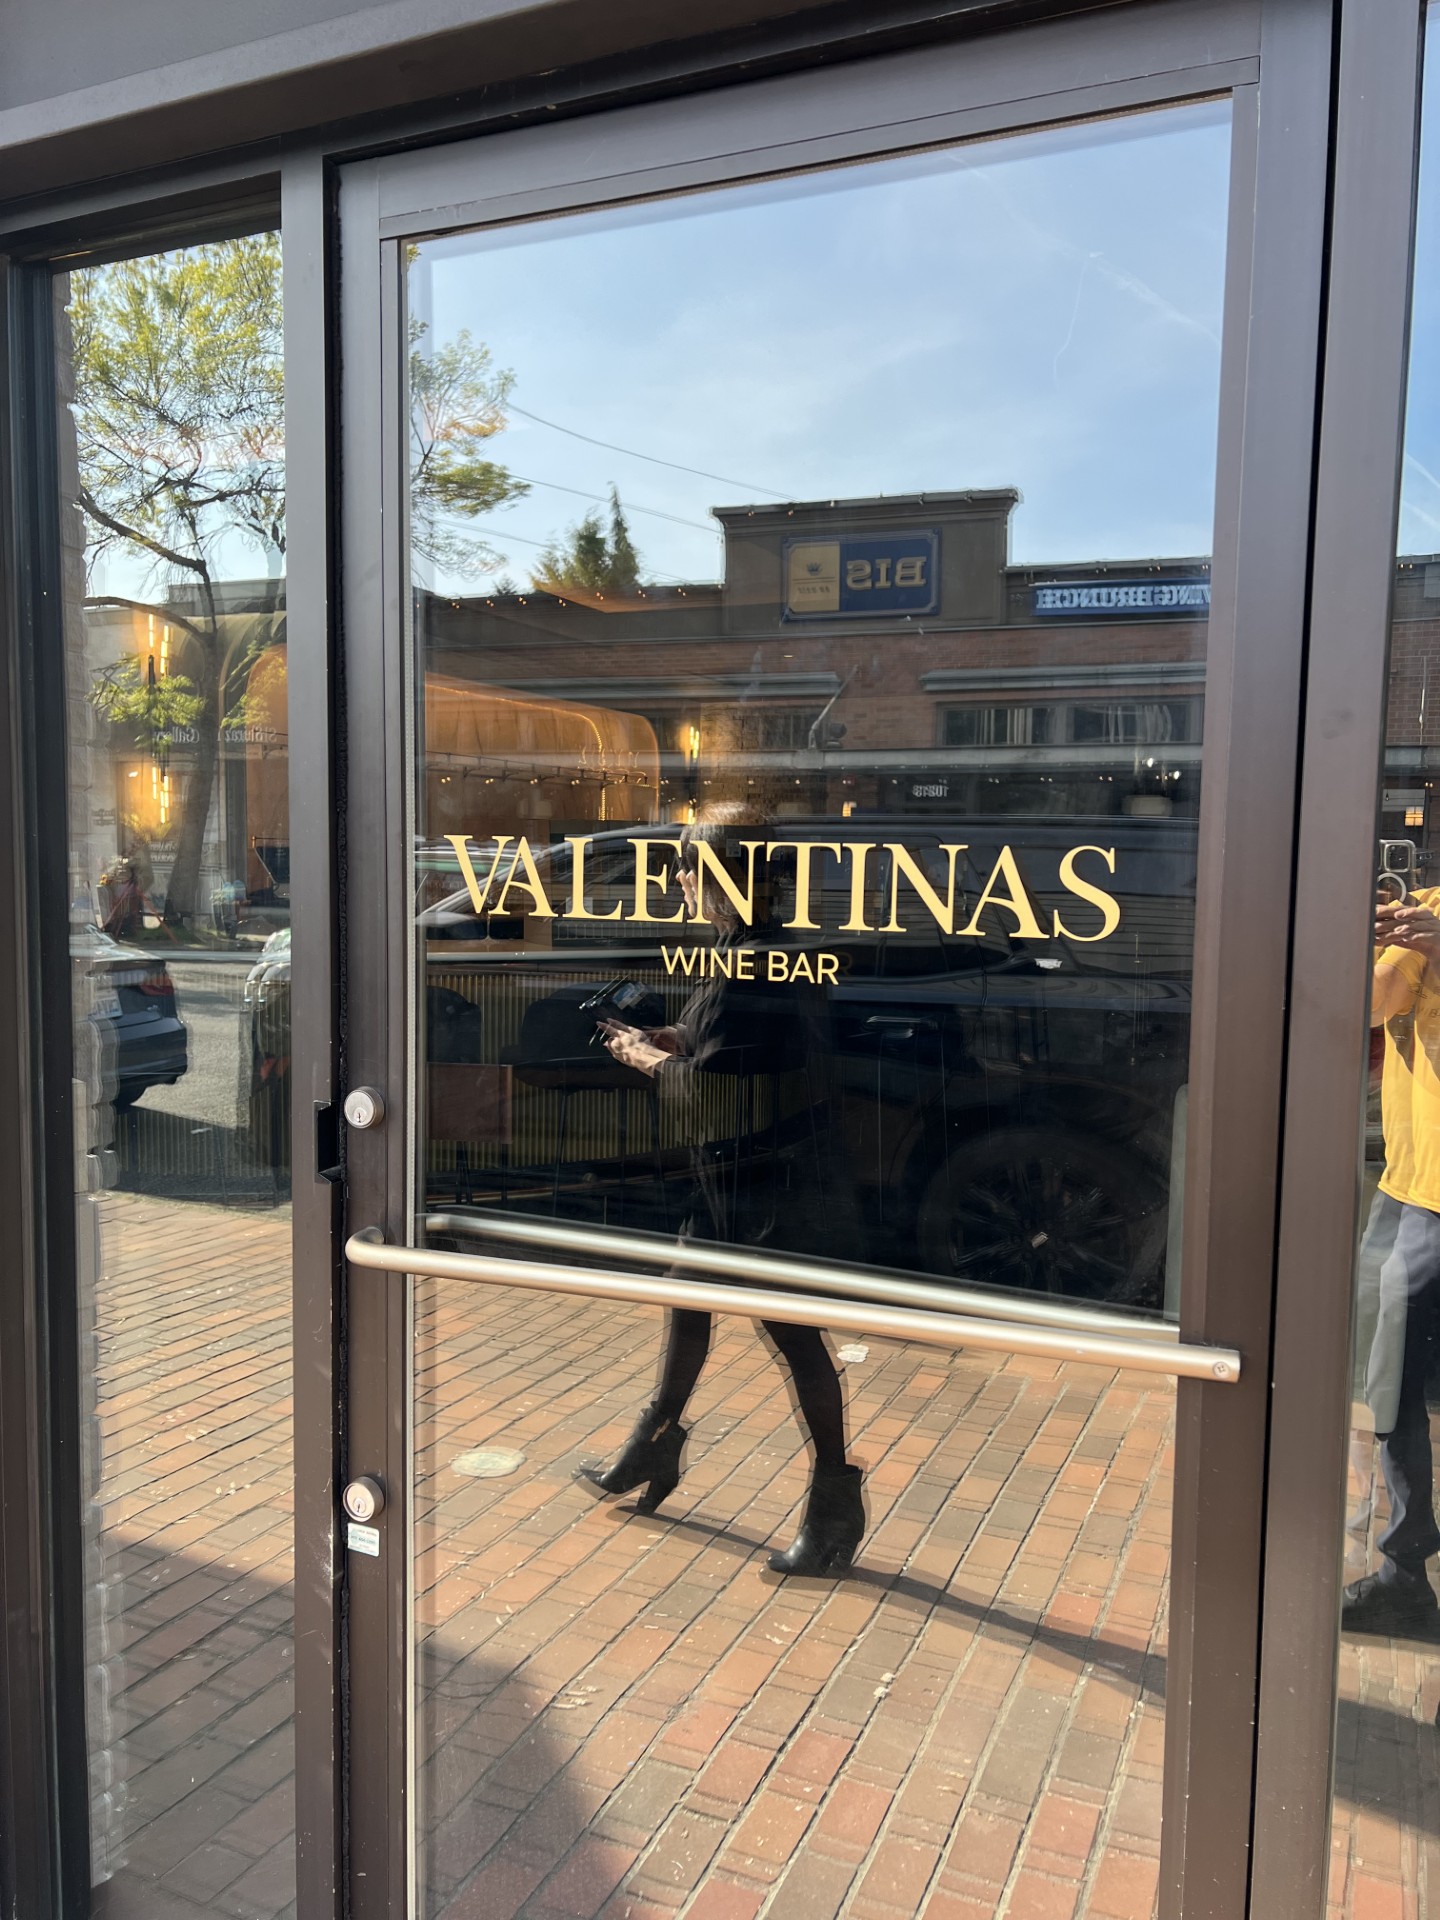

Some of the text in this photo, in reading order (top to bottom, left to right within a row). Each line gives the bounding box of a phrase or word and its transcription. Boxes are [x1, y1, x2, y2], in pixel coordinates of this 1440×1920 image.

[444, 835, 1121, 941] VALENTINAS
[661, 945, 840, 986] WINE BAR
